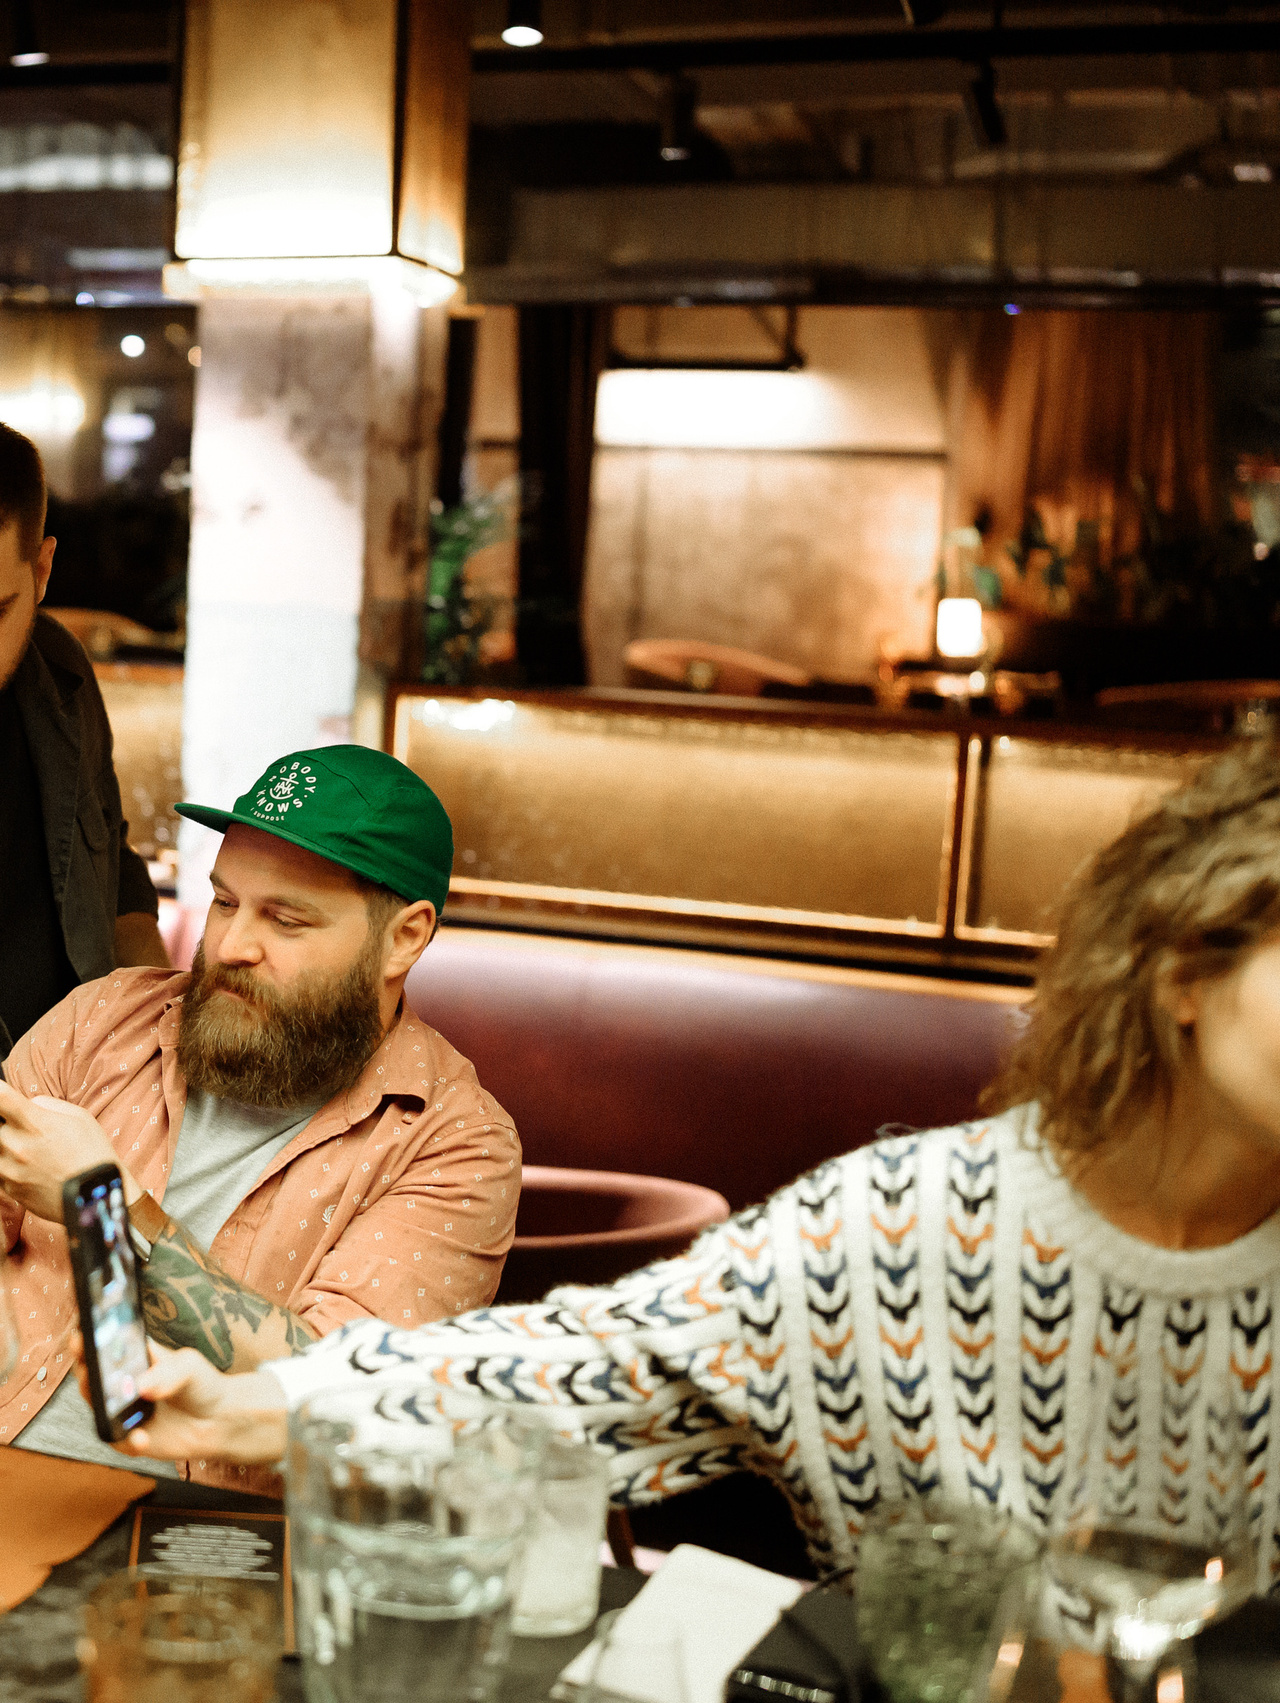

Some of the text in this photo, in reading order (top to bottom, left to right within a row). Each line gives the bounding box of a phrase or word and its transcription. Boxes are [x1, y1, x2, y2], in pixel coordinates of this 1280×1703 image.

[268, 761, 317, 793] NOBODY
[256, 789, 303, 813] KNOWS
[253, 811, 285, 821] SUPPOSE
